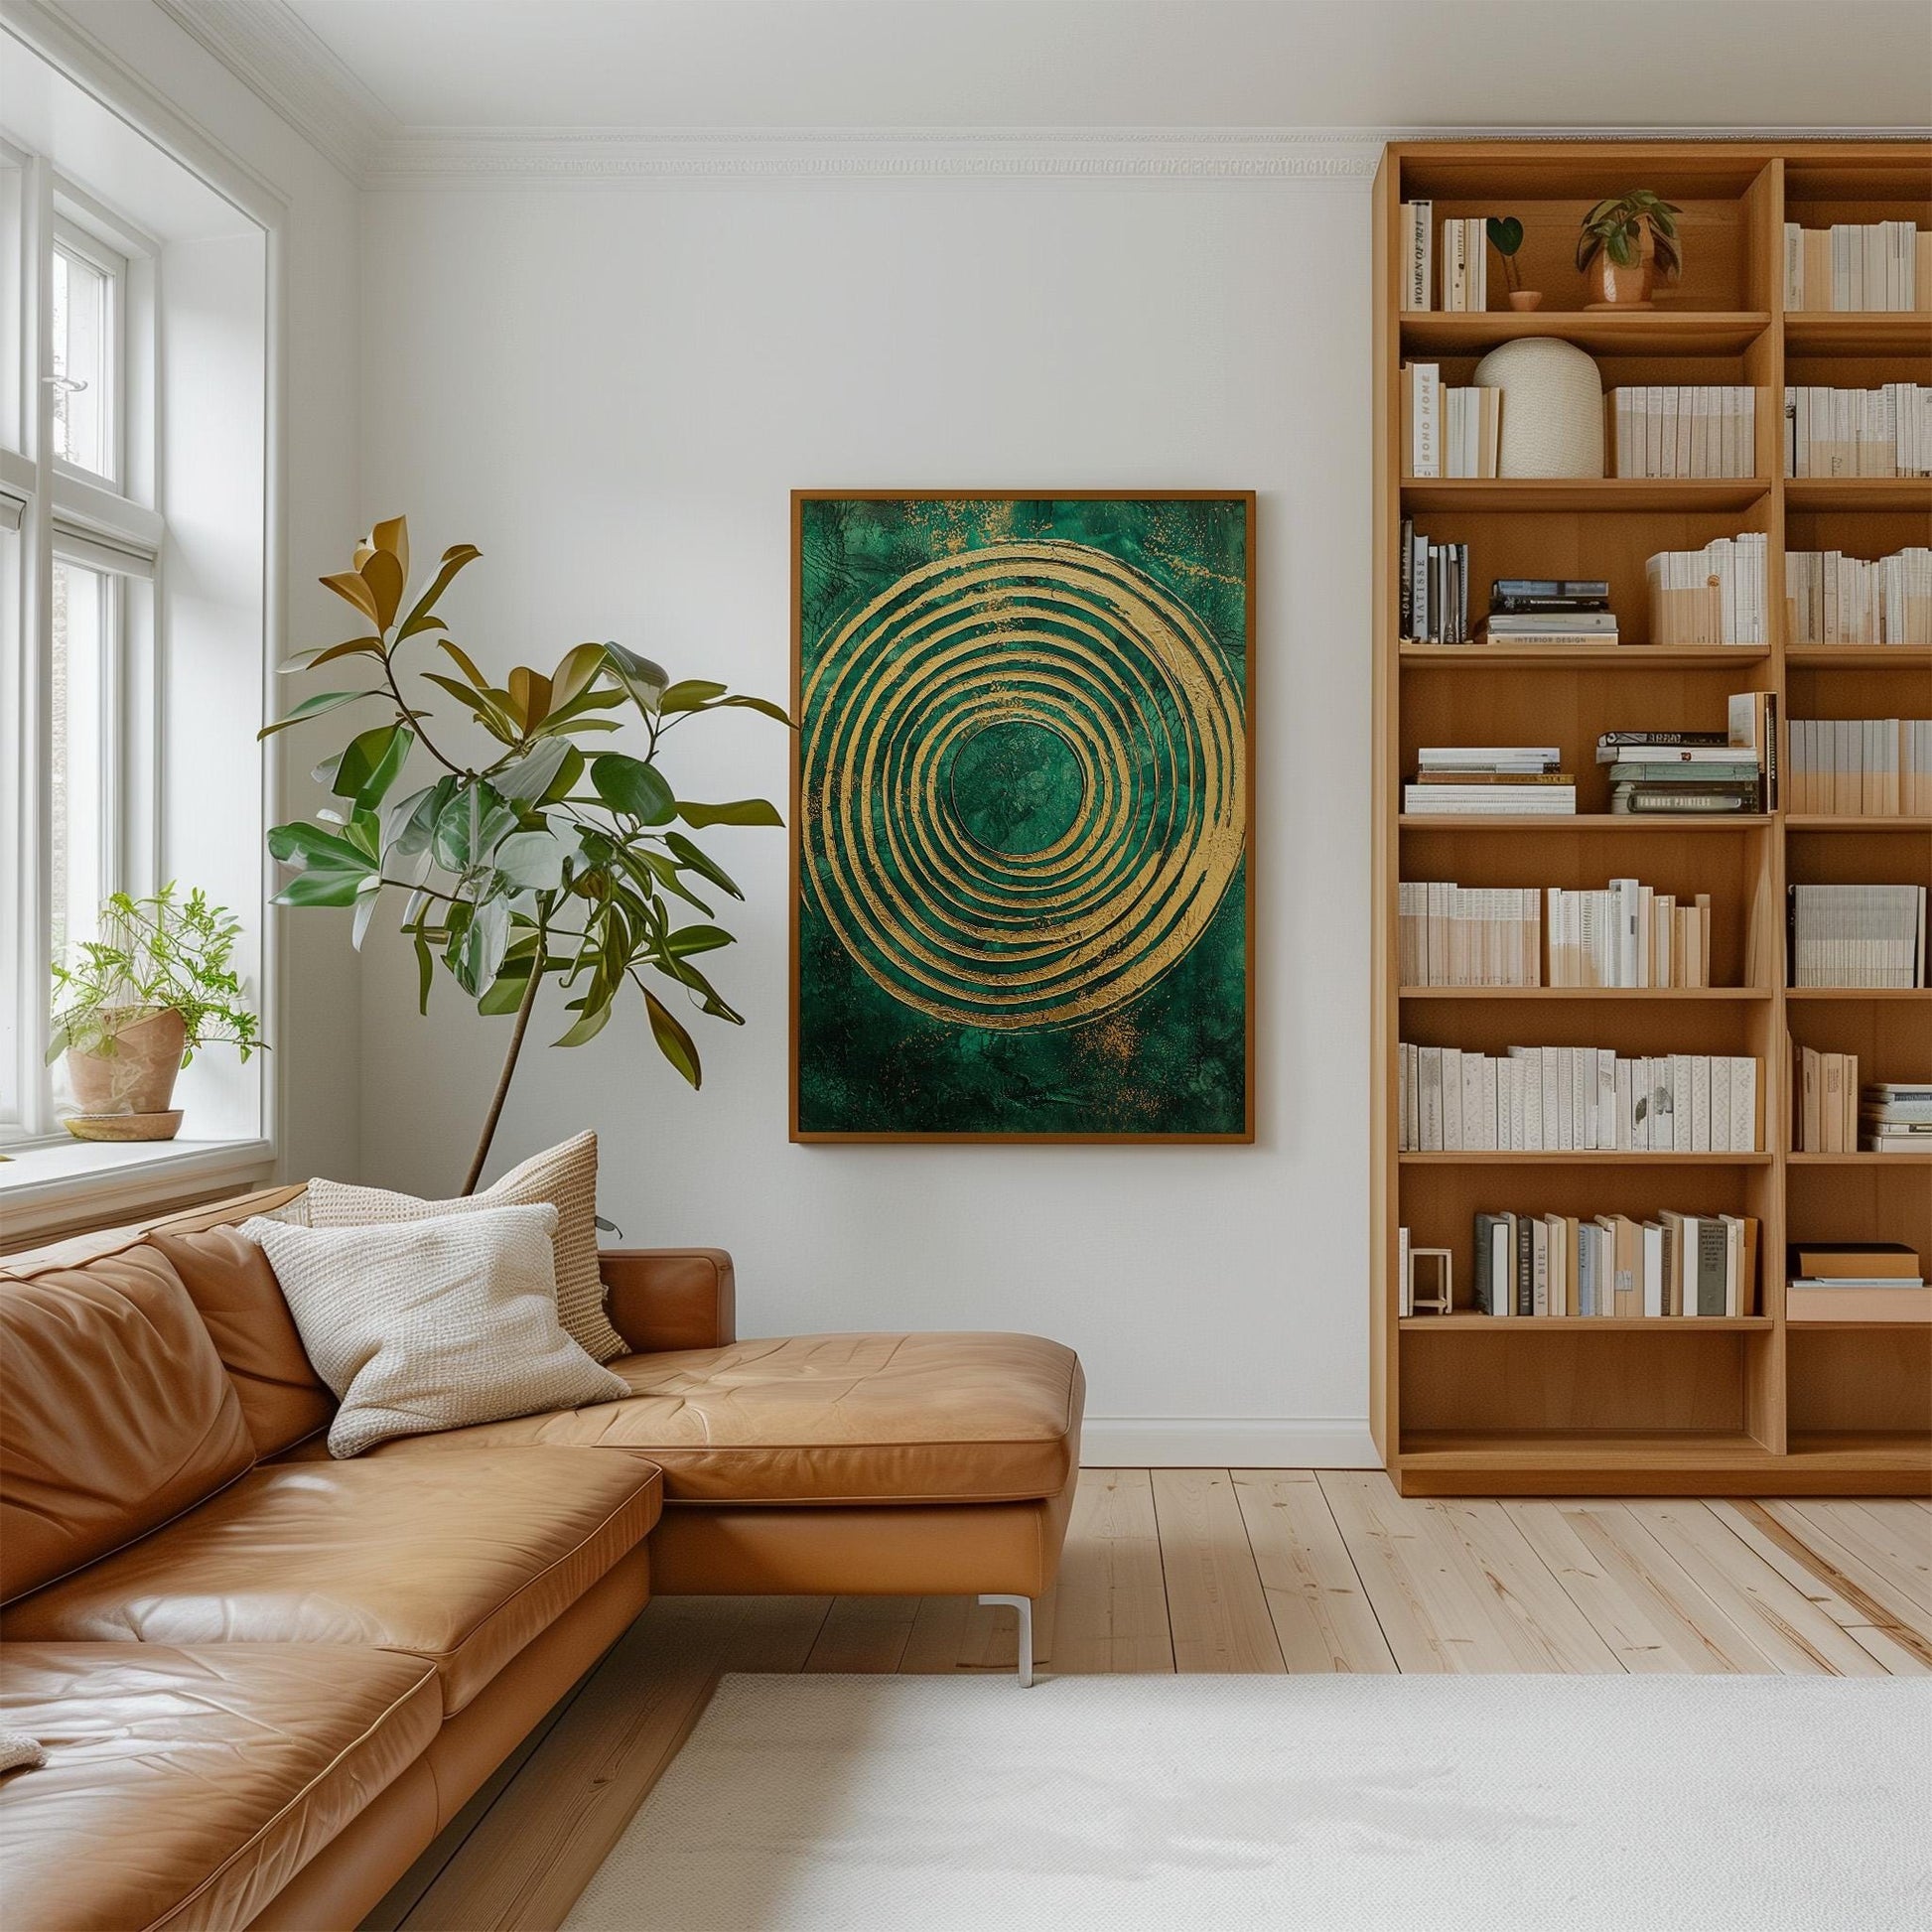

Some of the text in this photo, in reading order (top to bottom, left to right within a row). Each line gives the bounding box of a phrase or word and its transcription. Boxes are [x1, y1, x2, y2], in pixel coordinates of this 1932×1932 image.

[1414, 244, 1424, 260] OF
[1414, 261, 1424, 305] WOMEN
[1416, 558, 1425, 624] MATISSE
[1640, 797, 1711, 806] FAMOUS PAINTERS
[1537, 1245, 1546, 1306] IVY BIEL
